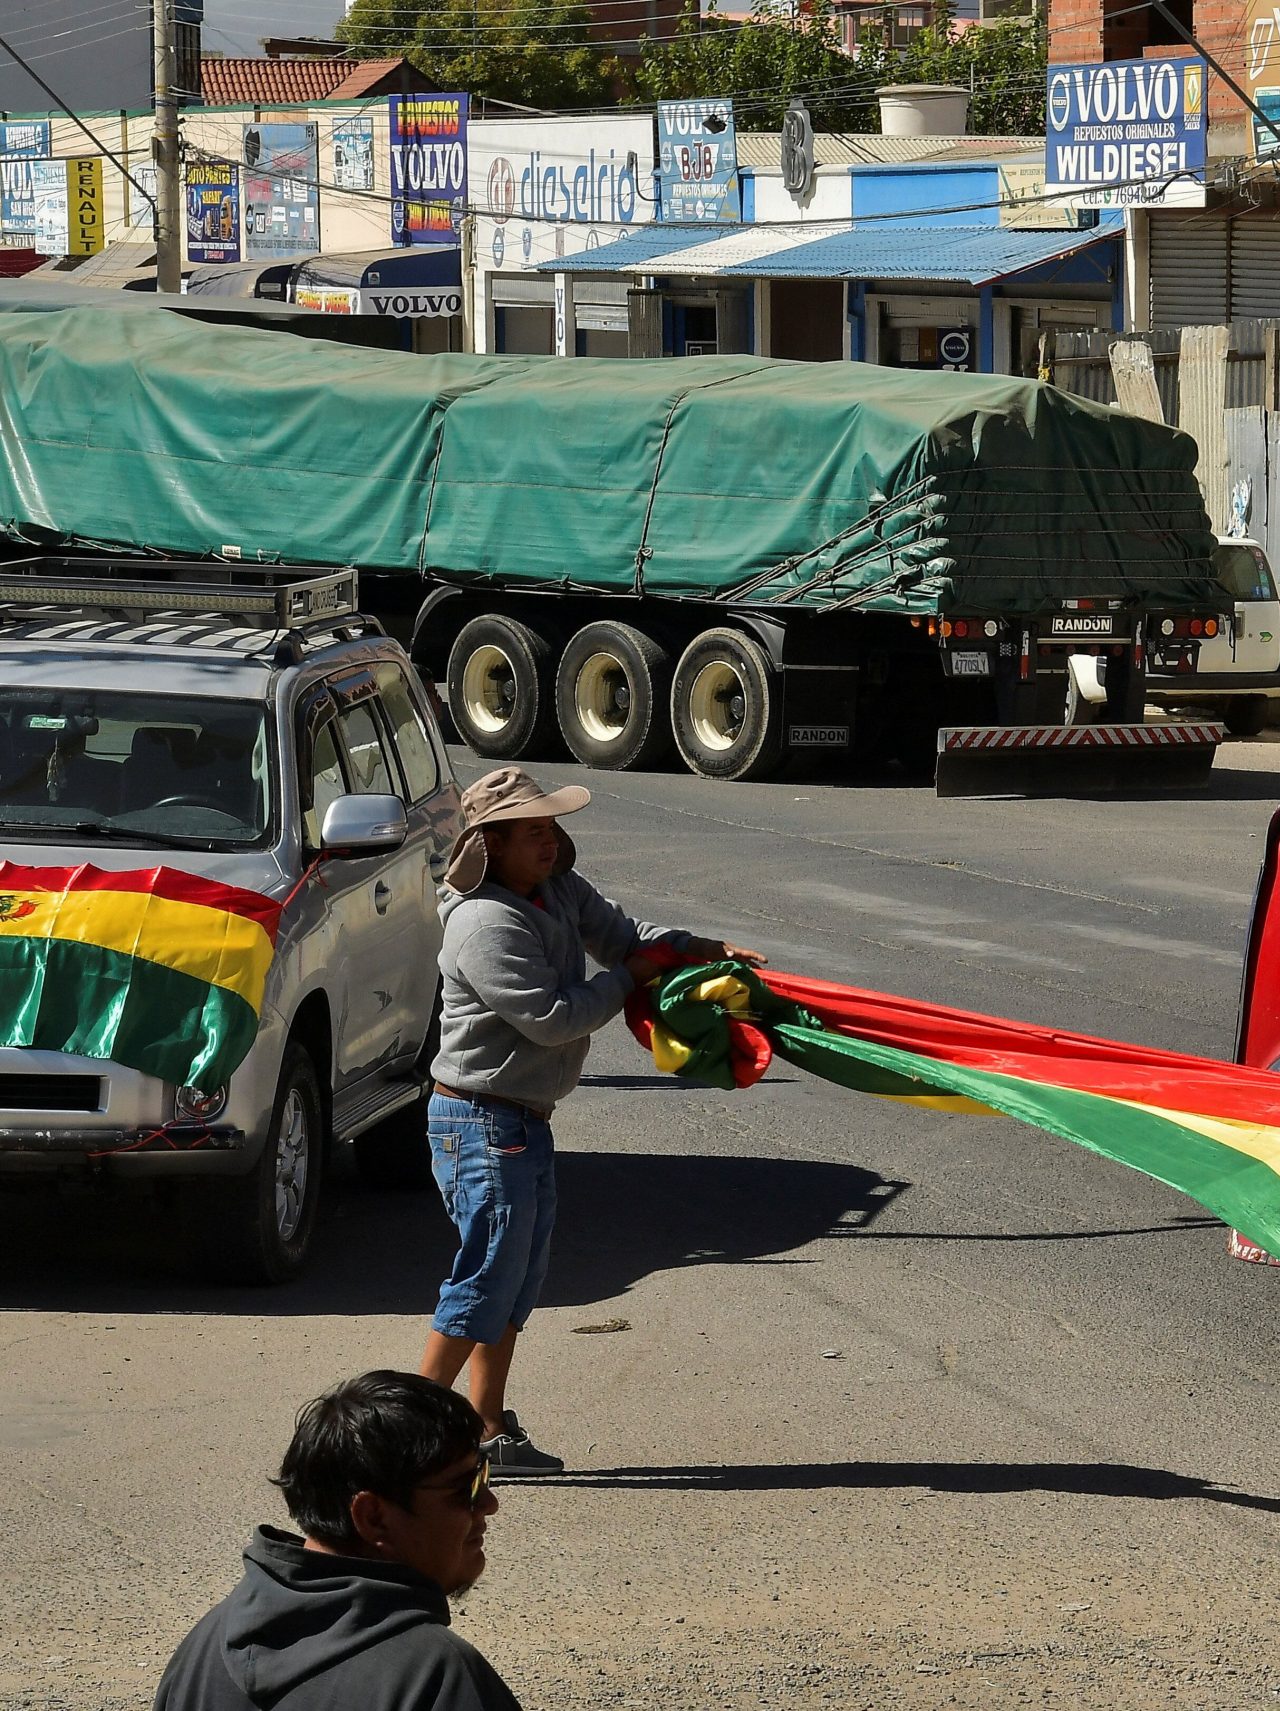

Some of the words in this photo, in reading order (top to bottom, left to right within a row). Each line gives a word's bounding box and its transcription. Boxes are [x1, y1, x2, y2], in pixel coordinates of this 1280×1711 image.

[1073, 63, 1178, 122] VOLVO
[397, 100, 459, 136] REPUESTOS
[1074, 125, 1123, 142] REPUESTOS
[1126, 122, 1176, 140] ORIGINALES
[391, 141, 465, 190] VOLVO
[681, 141, 713, 180] BJB
[1056, 142, 1192, 182] WILDIESEL
[521, 148, 635, 222] dieselrio
[672, 183, 701, 198] REPUESTOS
[78, 161, 96, 252] RENAULT
[369, 293, 462, 314] VOLVO
[1055, 618, 1110, 631] RANDON
[792, 730, 845, 742] RANDON
